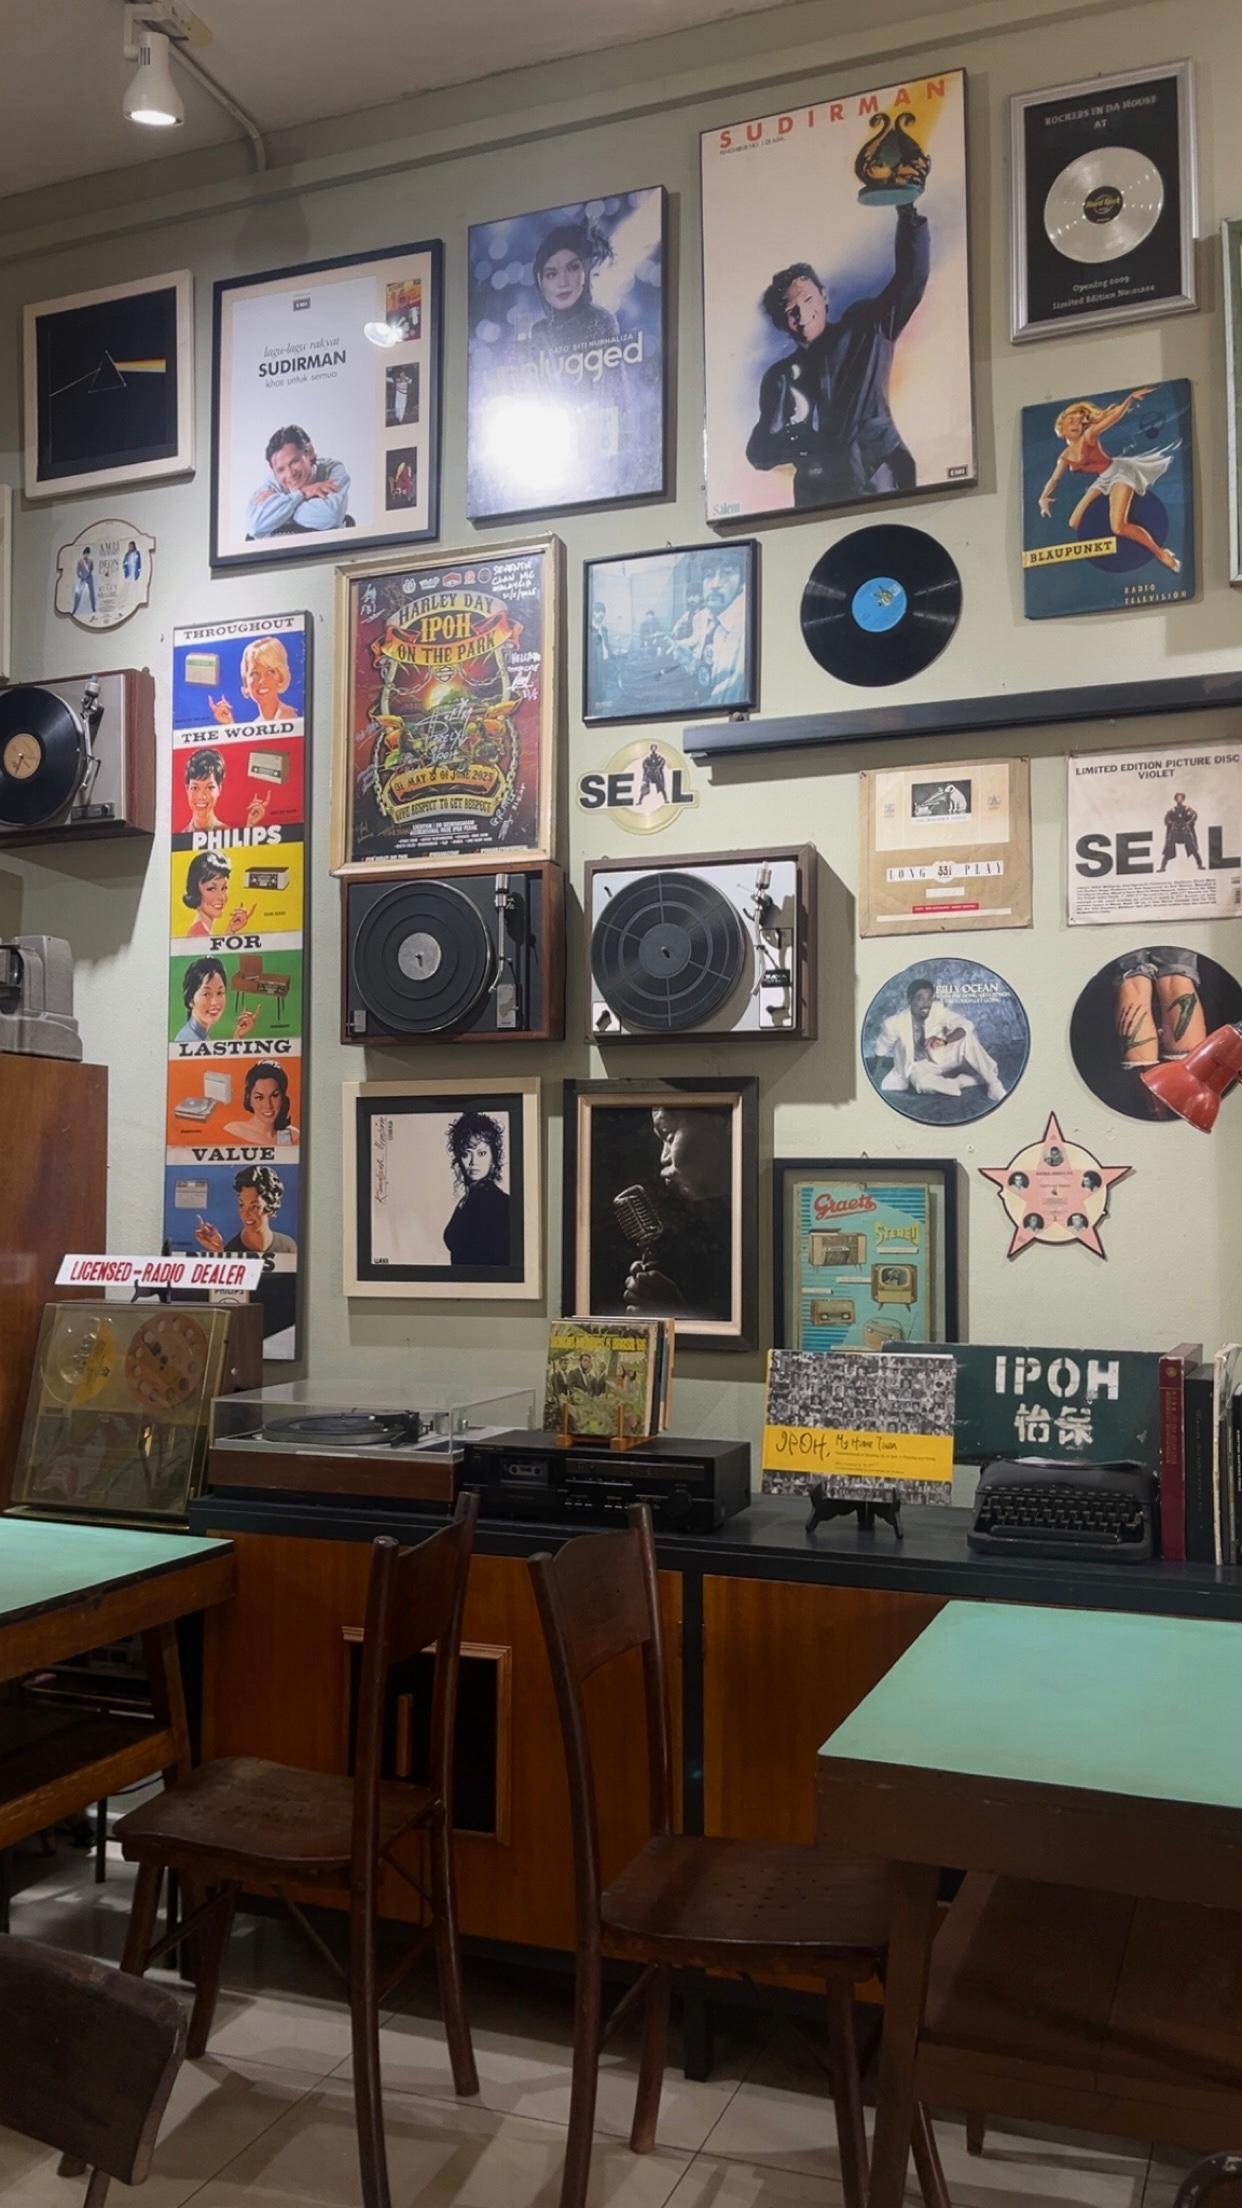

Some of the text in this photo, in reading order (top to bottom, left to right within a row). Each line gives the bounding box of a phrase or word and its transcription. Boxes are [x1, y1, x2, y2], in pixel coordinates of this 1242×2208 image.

[719, 79, 945, 149] SUDIRMAN
[1094, 119, 1107, 129] AT
[1072, 280, 1108, 292] Opening
[258, 349, 346, 378] SUDIRMAN
[1029, 541, 1113, 563] BLAUPUNKT
[1124, 584, 1156, 594] RADIO
[1124, 591, 1187, 605] TELEVISION
[400, 593, 458, 625] HARLEY
[464, 593, 494, 613] DAY
[184, 617, 294, 640] THROUGHOUT
[420, 613, 473, 642] IPOH
[398, 630, 496, 663] ON THE PARK
[182, 722, 294, 744] THE WORLD
[1076, 754, 1241, 776] LIMITED EDITION PICTURE DISC
[1138, 769, 1175, 780] VIOLET
[408, 774, 426, 785] MAY
[192, 824, 282, 851] PHILIPS
[889, 869, 926, 881] LONG
[965, 862, 1002, 875] PLAY
[210, 935, 262, 951] FOR
[961, 983, 999, 994] OCEAN
[179, 1038, 292, 1057] LASTING
[192, 1147, 275, 1162] VALUE
[191, 1264, 247, 1285] DEALER
[995, 1355, 1120, 1400] IPOH
[835, 1433, 849, 1450] My
[851, 1434, 873, 1450] Home
